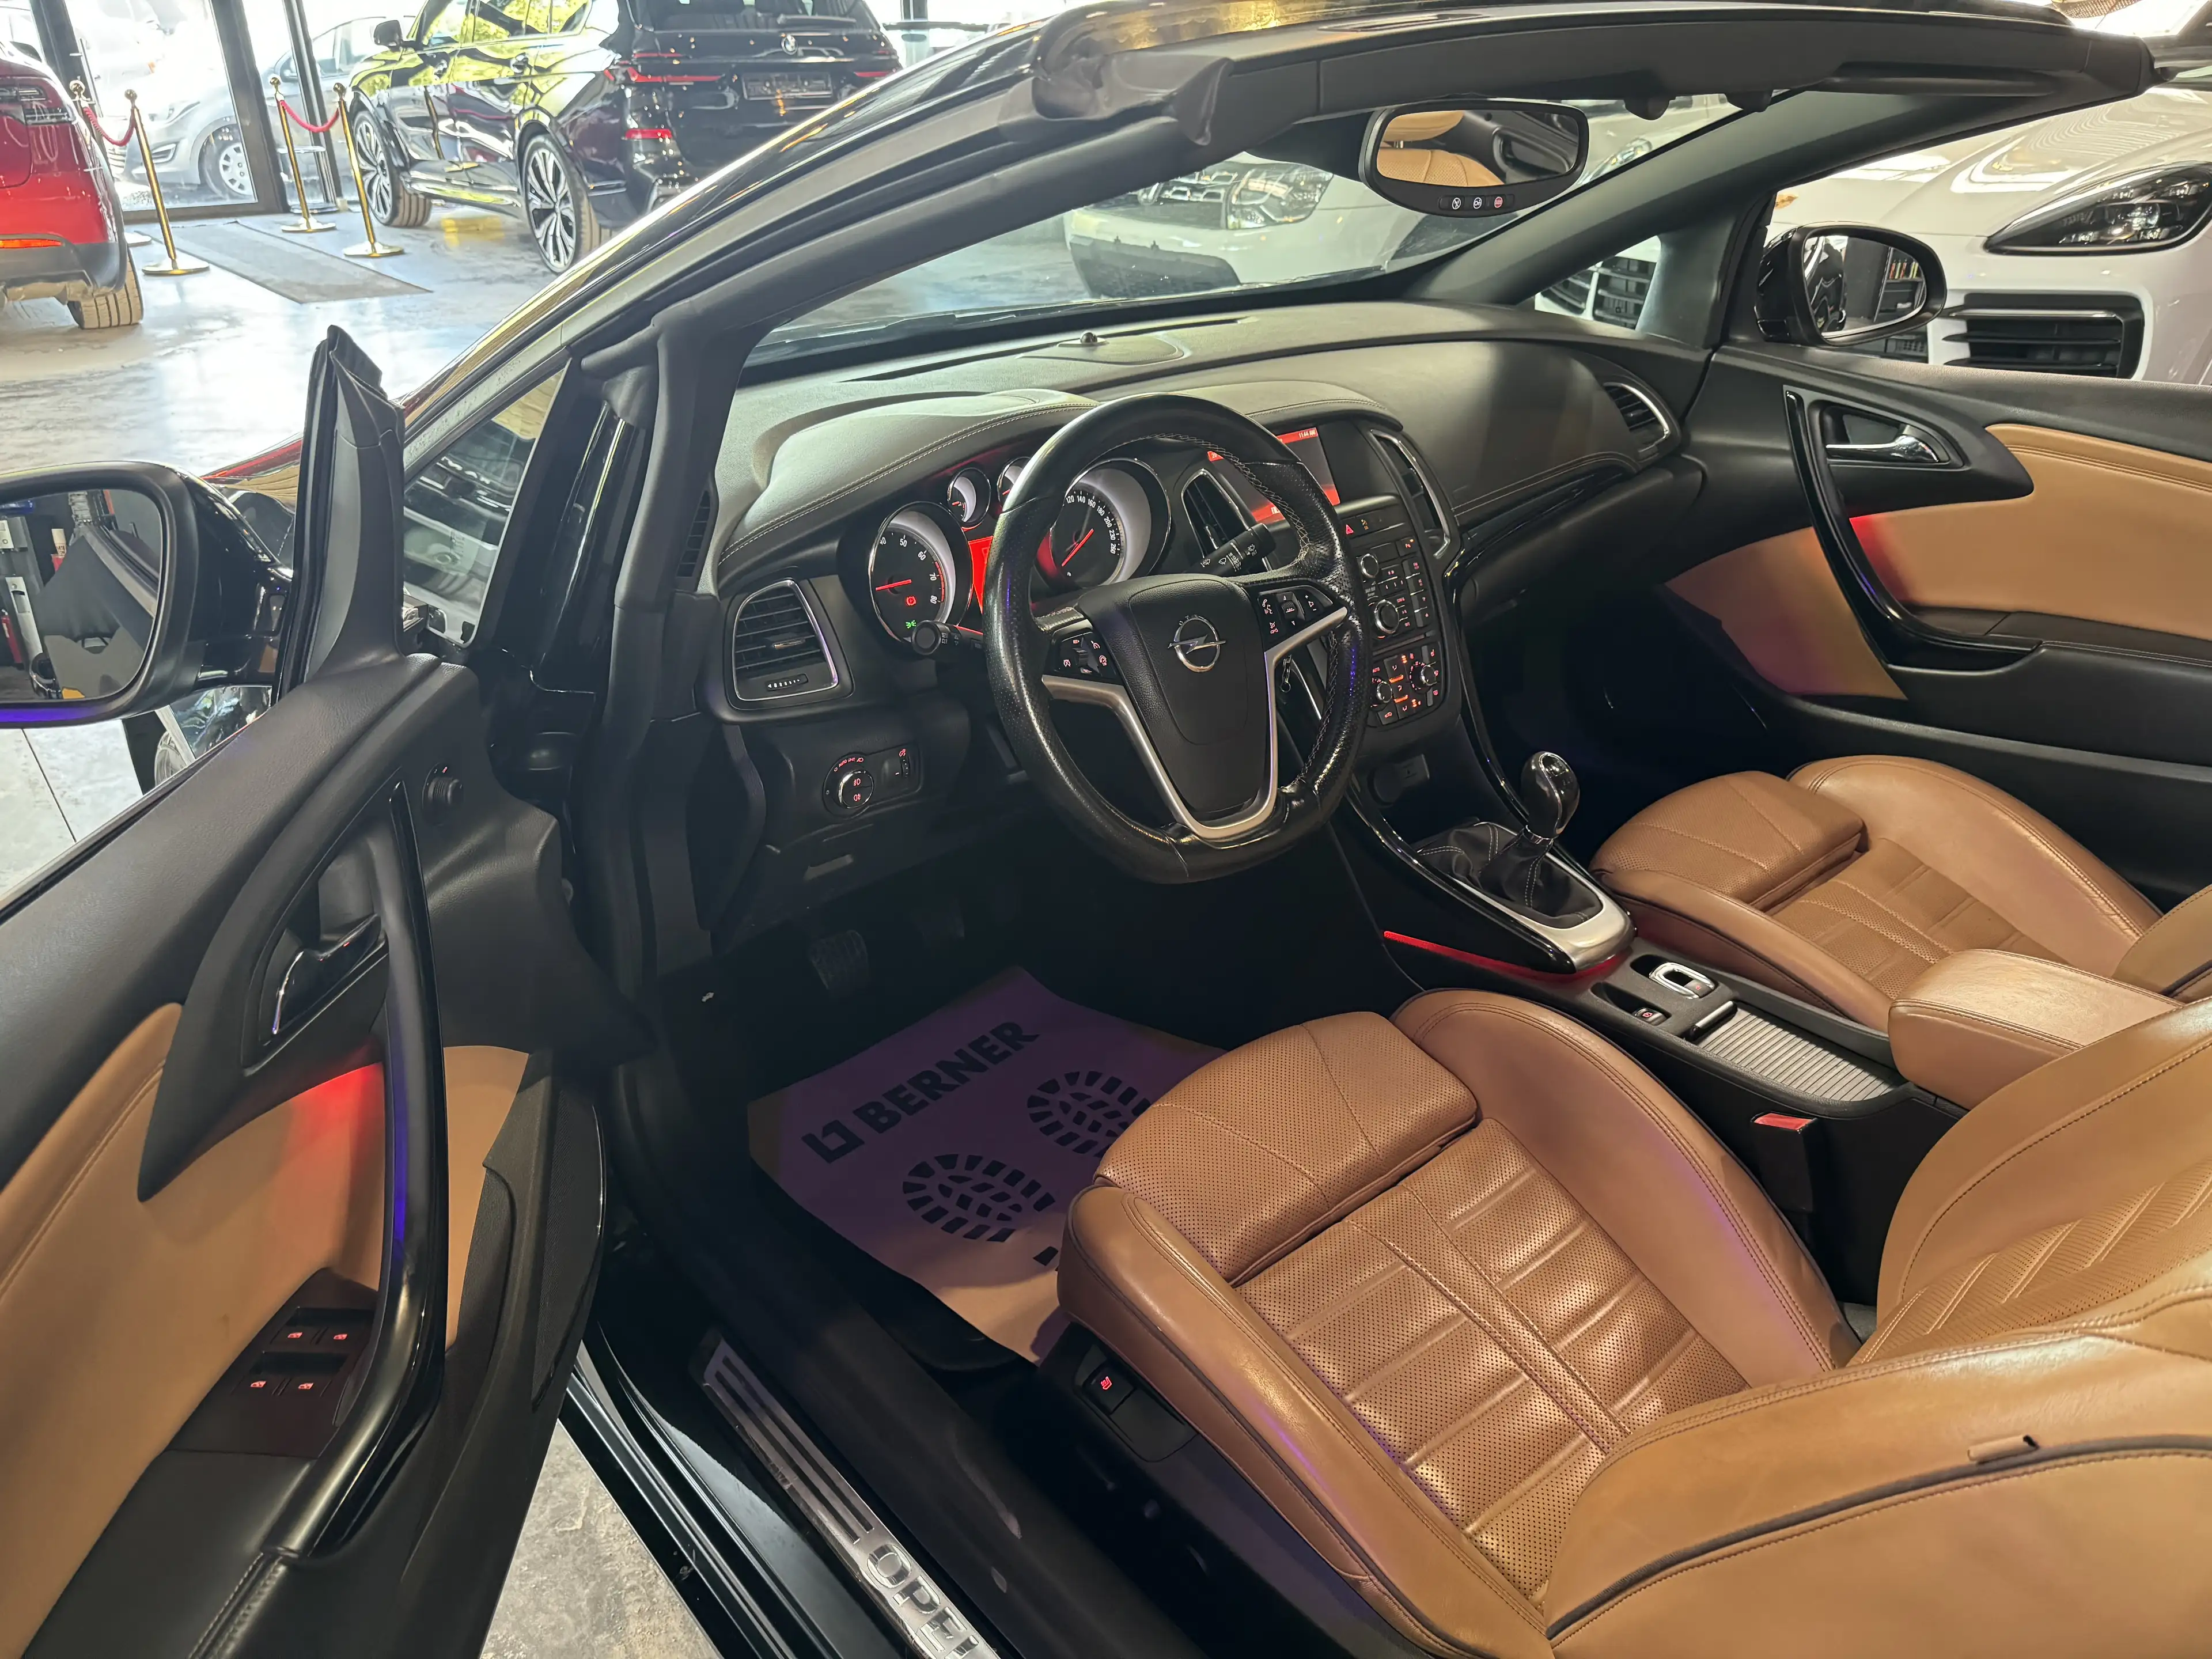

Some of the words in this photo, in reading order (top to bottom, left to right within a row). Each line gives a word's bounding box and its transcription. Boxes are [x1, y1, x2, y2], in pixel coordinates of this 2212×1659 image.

[1066, 495, 1075, 503] 120
[1077, 495, 1086, 503] 140
[1088, 499, 1096, 508] 160
[1096, 506, 1105, 516] 180
[1104, 516, 1112, 528] 200
[900, 538, 908, 547] 50
[918, 551, 926, 560] 60
[929, 572, 937, 581] 70
[930, 595, 938, 604] 80
[852, 1021, 1040, 1134] BERNER
